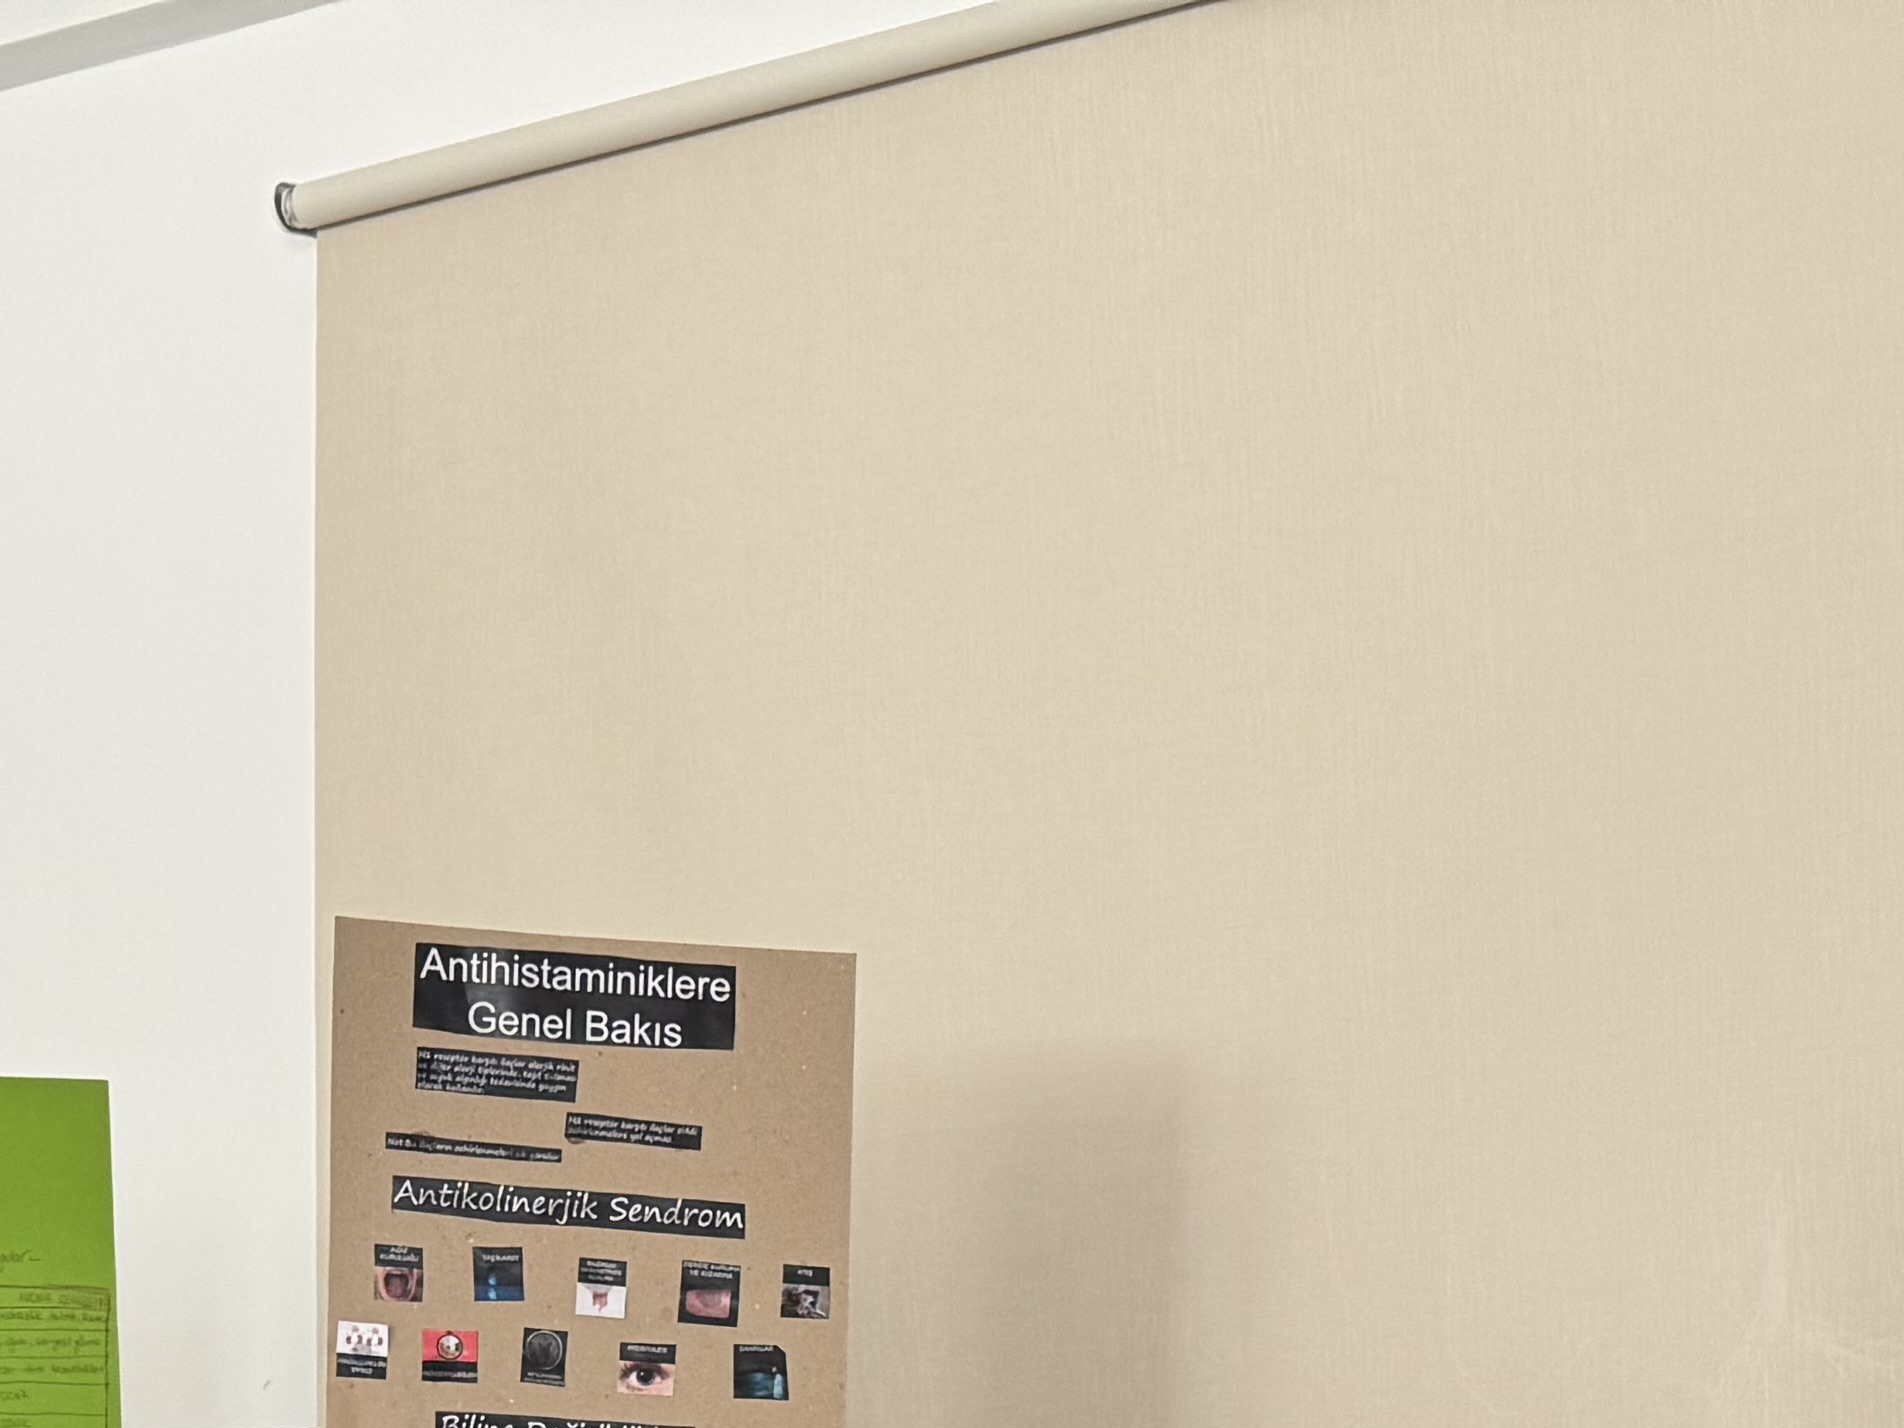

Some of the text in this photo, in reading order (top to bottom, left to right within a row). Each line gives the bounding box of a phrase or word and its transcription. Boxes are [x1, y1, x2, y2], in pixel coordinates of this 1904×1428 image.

[420, 947, 731, 1003] Antihistaminiklere
[468, 1001, 572, 1041] Genel
[394, 1178, 744, 1229] Antikolinerjik Sendrom
